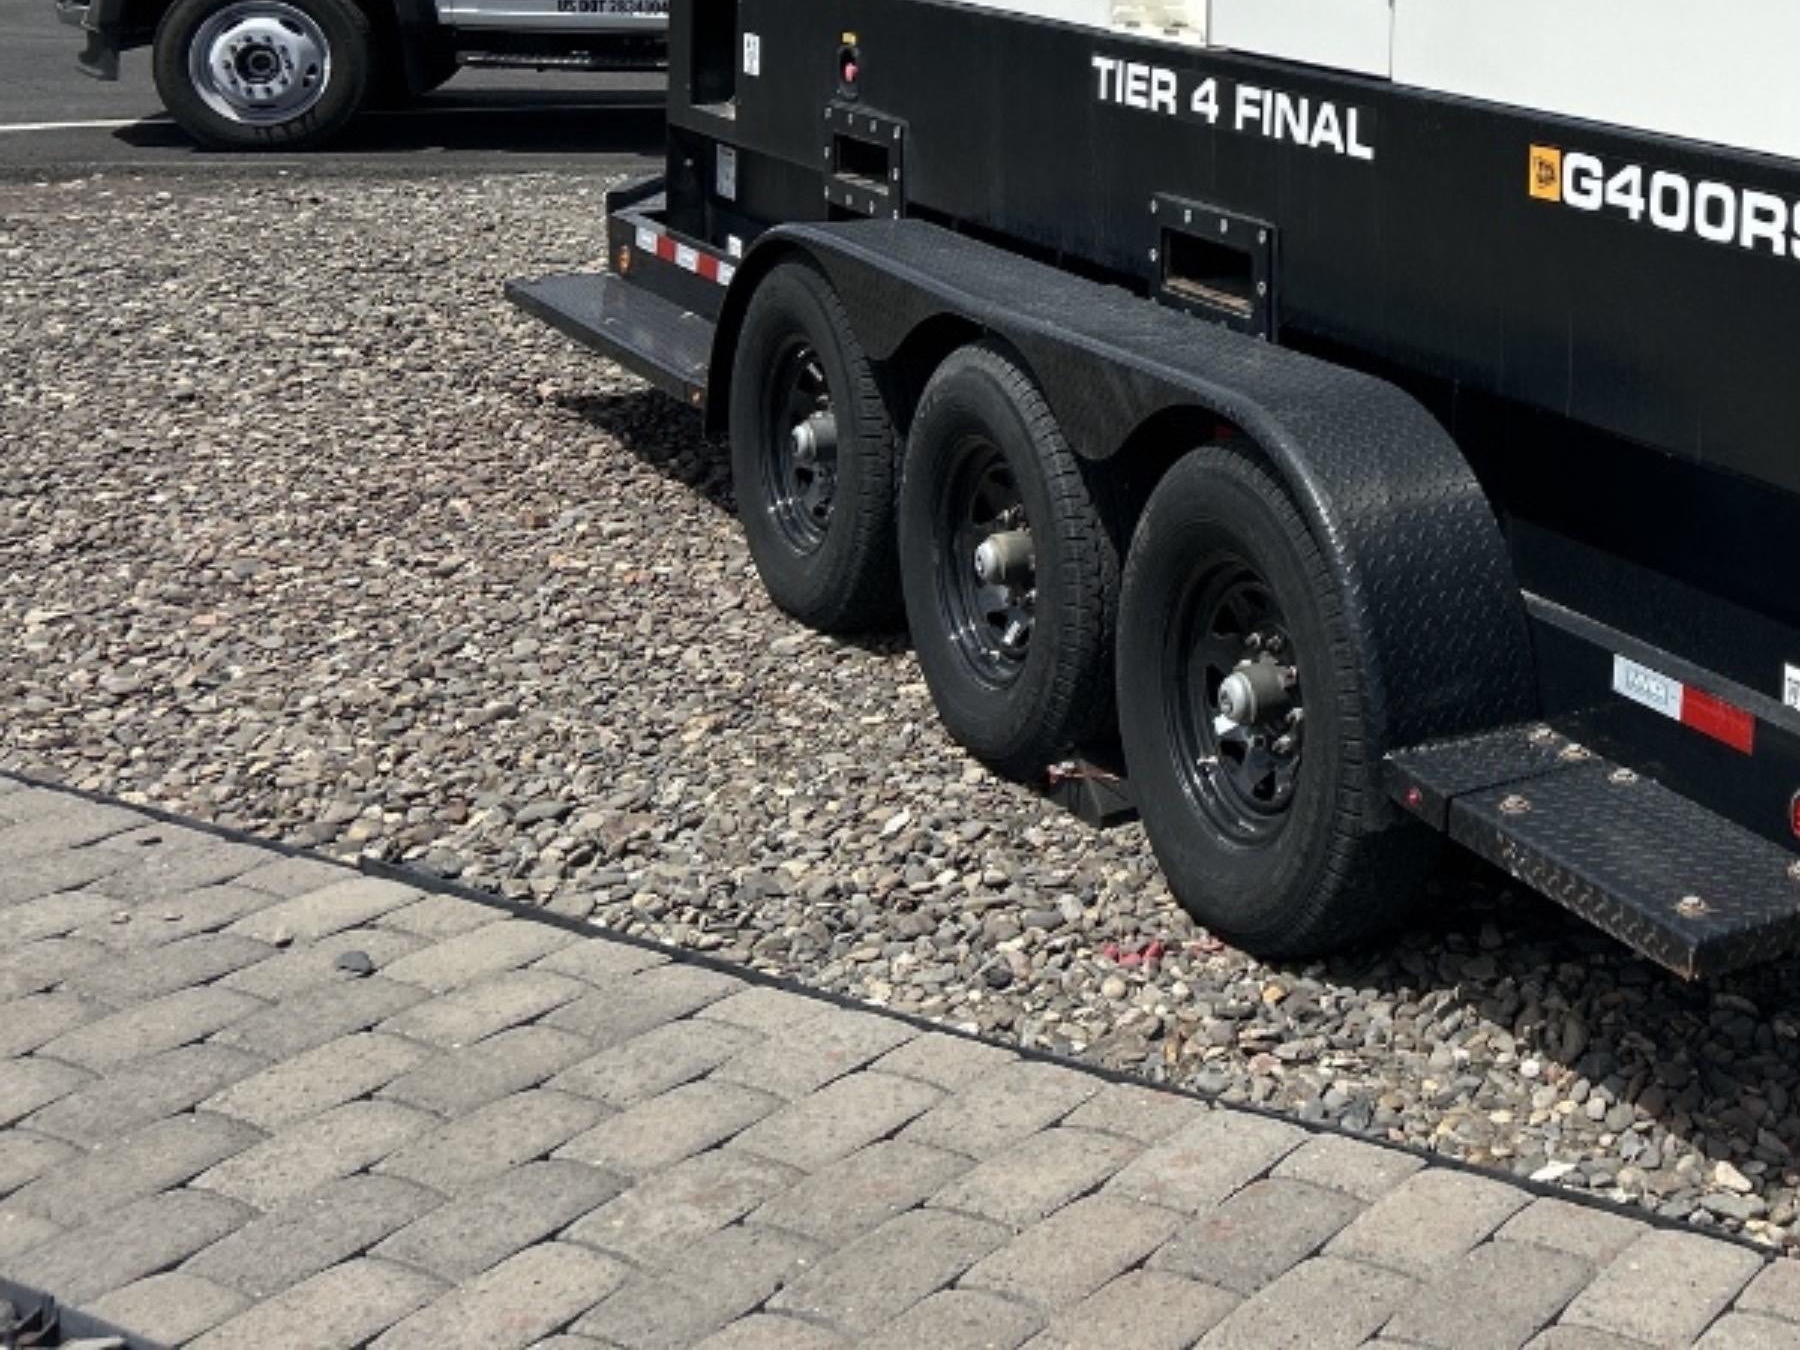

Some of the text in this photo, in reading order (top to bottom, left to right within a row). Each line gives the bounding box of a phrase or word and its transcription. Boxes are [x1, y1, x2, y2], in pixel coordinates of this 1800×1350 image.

[1091, 55, 1375, 160] TIER 4 FINAL
